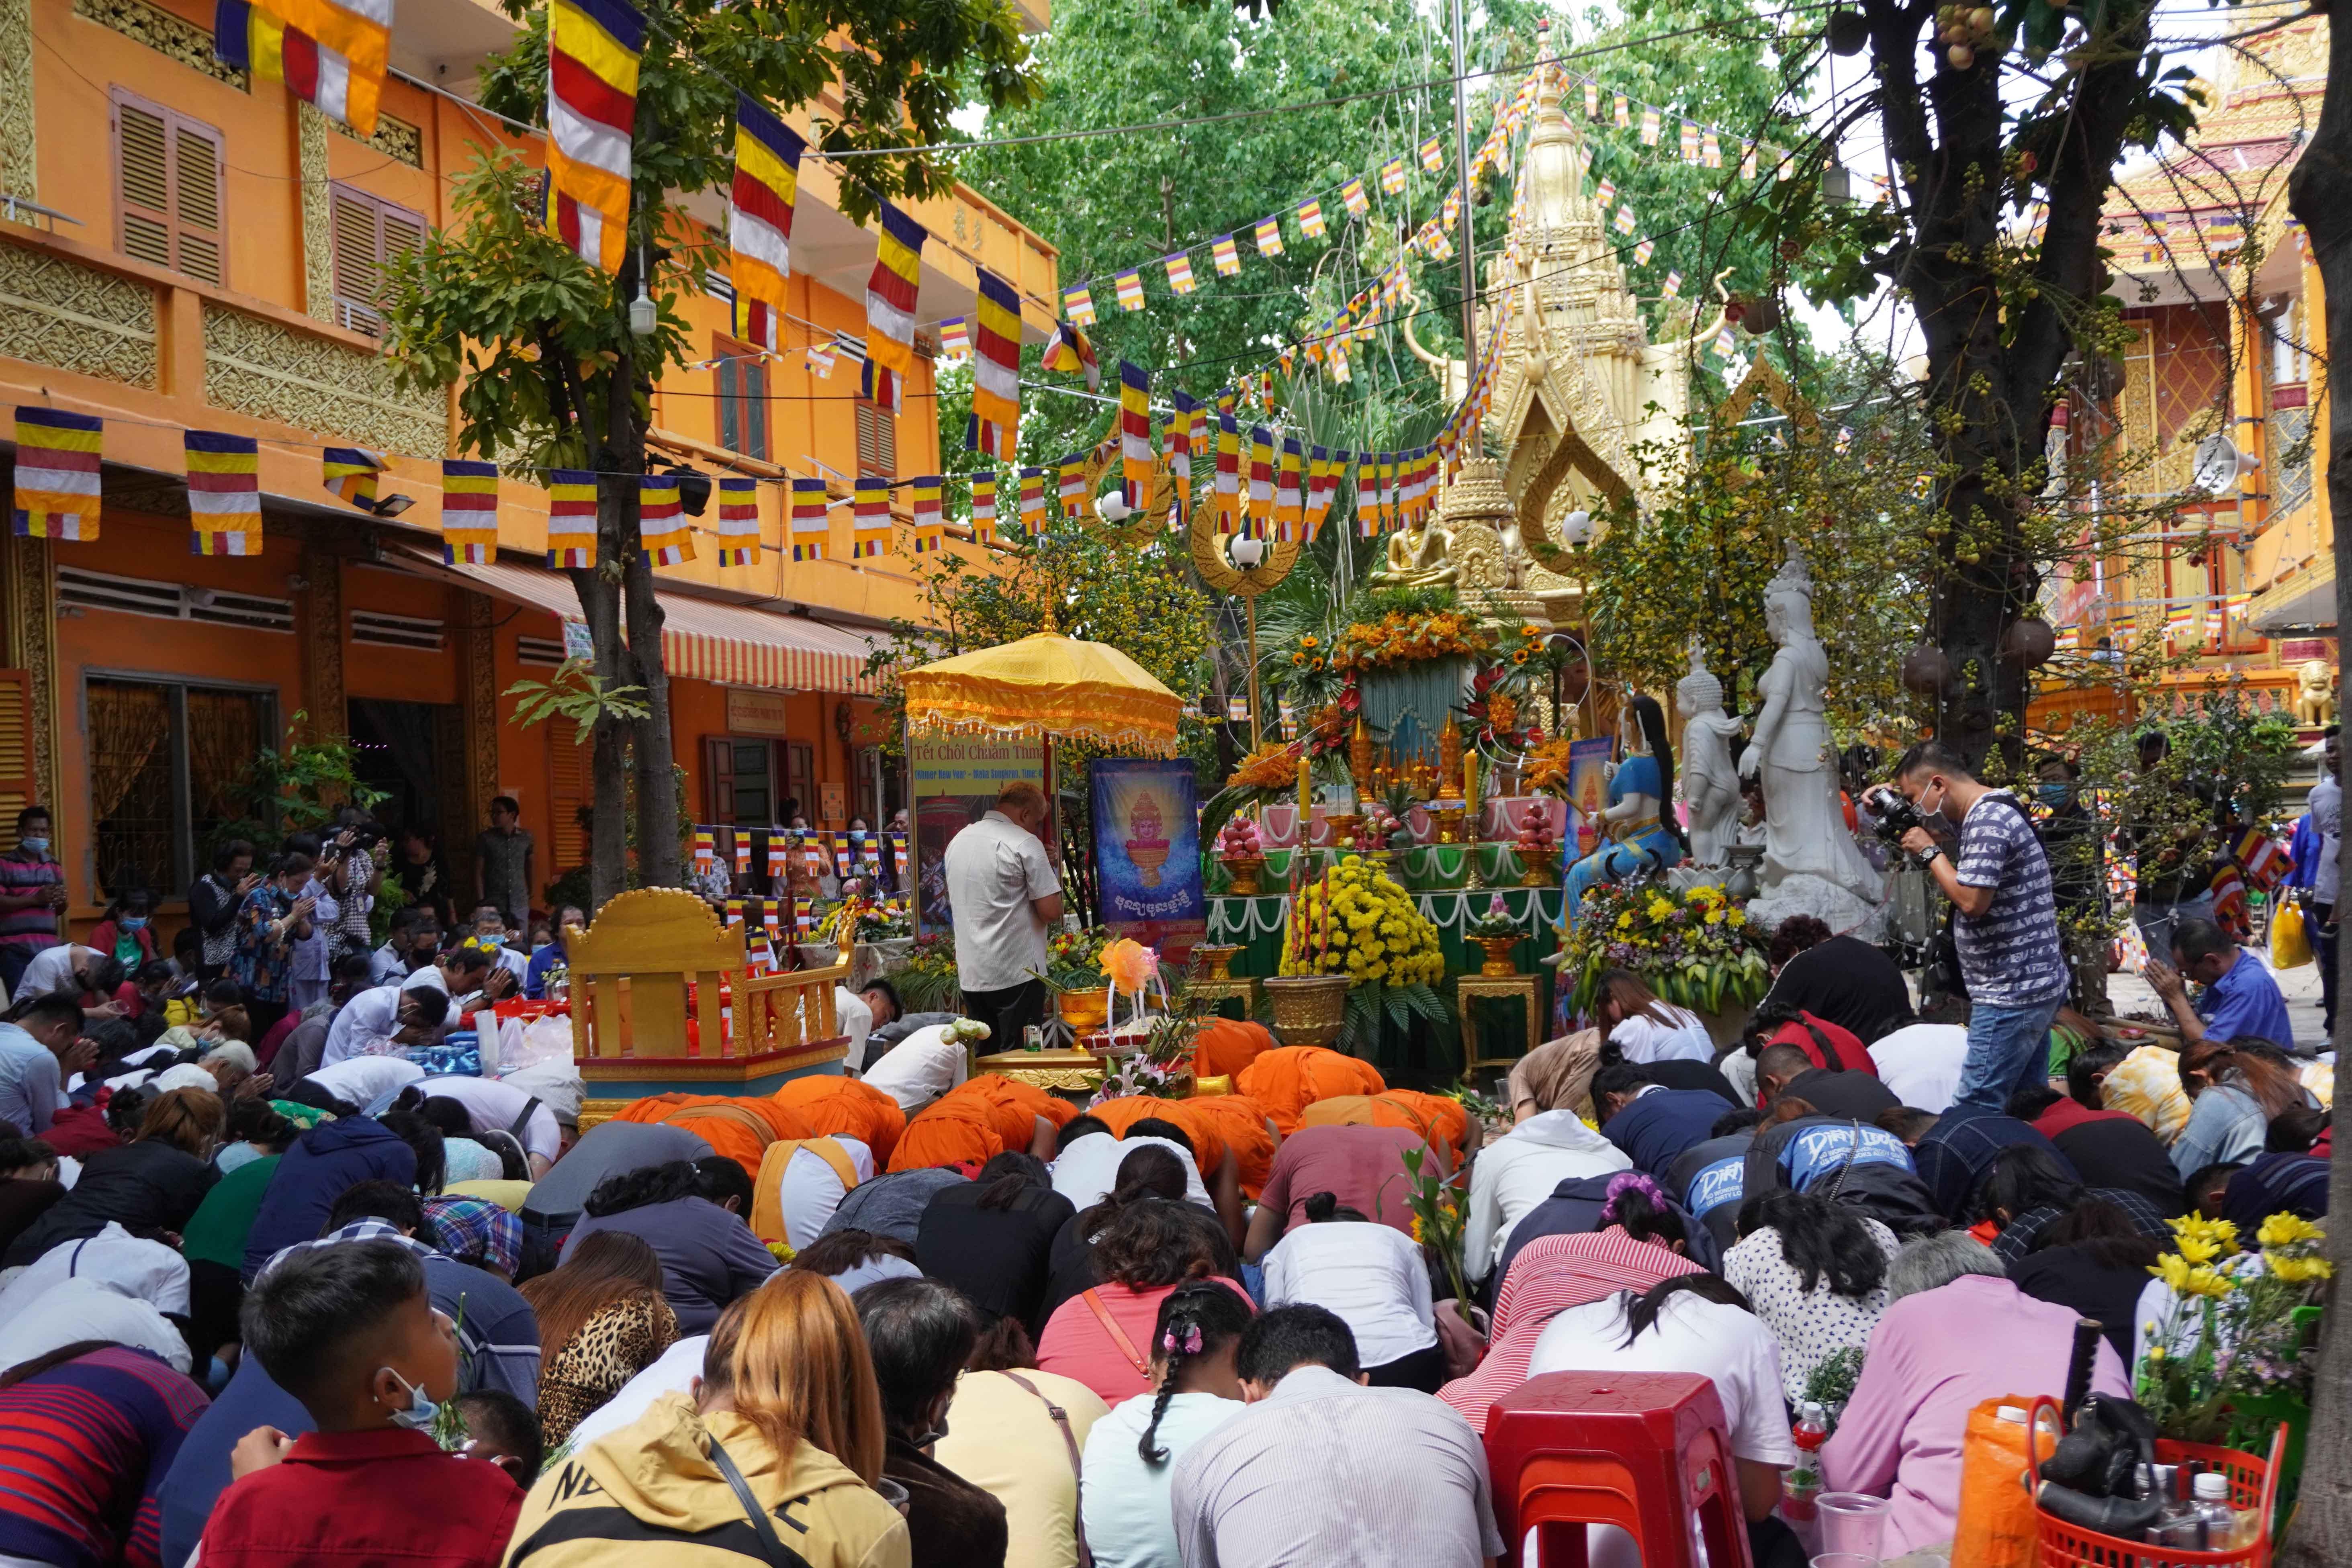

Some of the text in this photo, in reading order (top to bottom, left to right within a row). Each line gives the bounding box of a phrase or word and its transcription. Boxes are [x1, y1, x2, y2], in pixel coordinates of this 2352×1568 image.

[914, 741, 934, 760] Tết
[938, 744, 965, 760] Chôl
[939, 769, 951, 779] New
[953, 769, 966, 778] Year
[974, 769, 989, 778] Maha
[1714, 1185, 1740, 1196] WONDER
[1715, 1192, 1732, 1203] DIRTY
